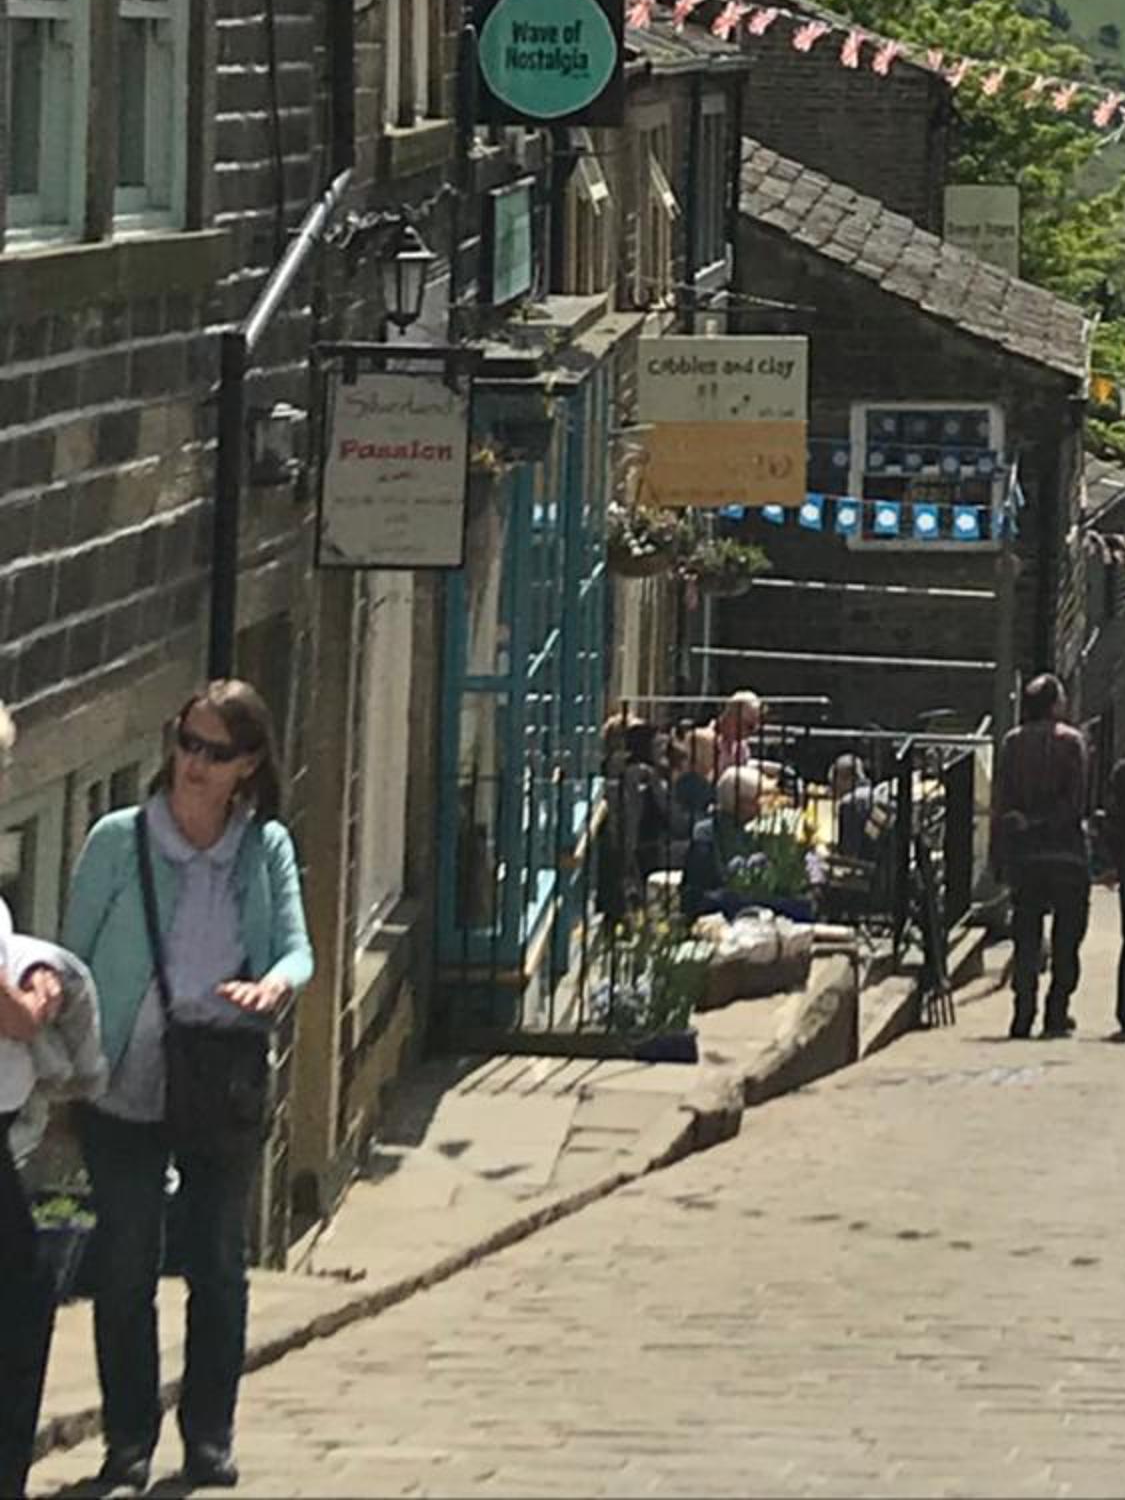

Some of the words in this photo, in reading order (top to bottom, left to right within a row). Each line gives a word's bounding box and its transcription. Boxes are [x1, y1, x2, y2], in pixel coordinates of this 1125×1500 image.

[511, 19, 559, 44] Wave
[562, 19, 583, 44] of
[505, 47, 590, 76] Nostalgia
[722, 356, 753, 376] and
[339, 438, 453, 461] Passion
